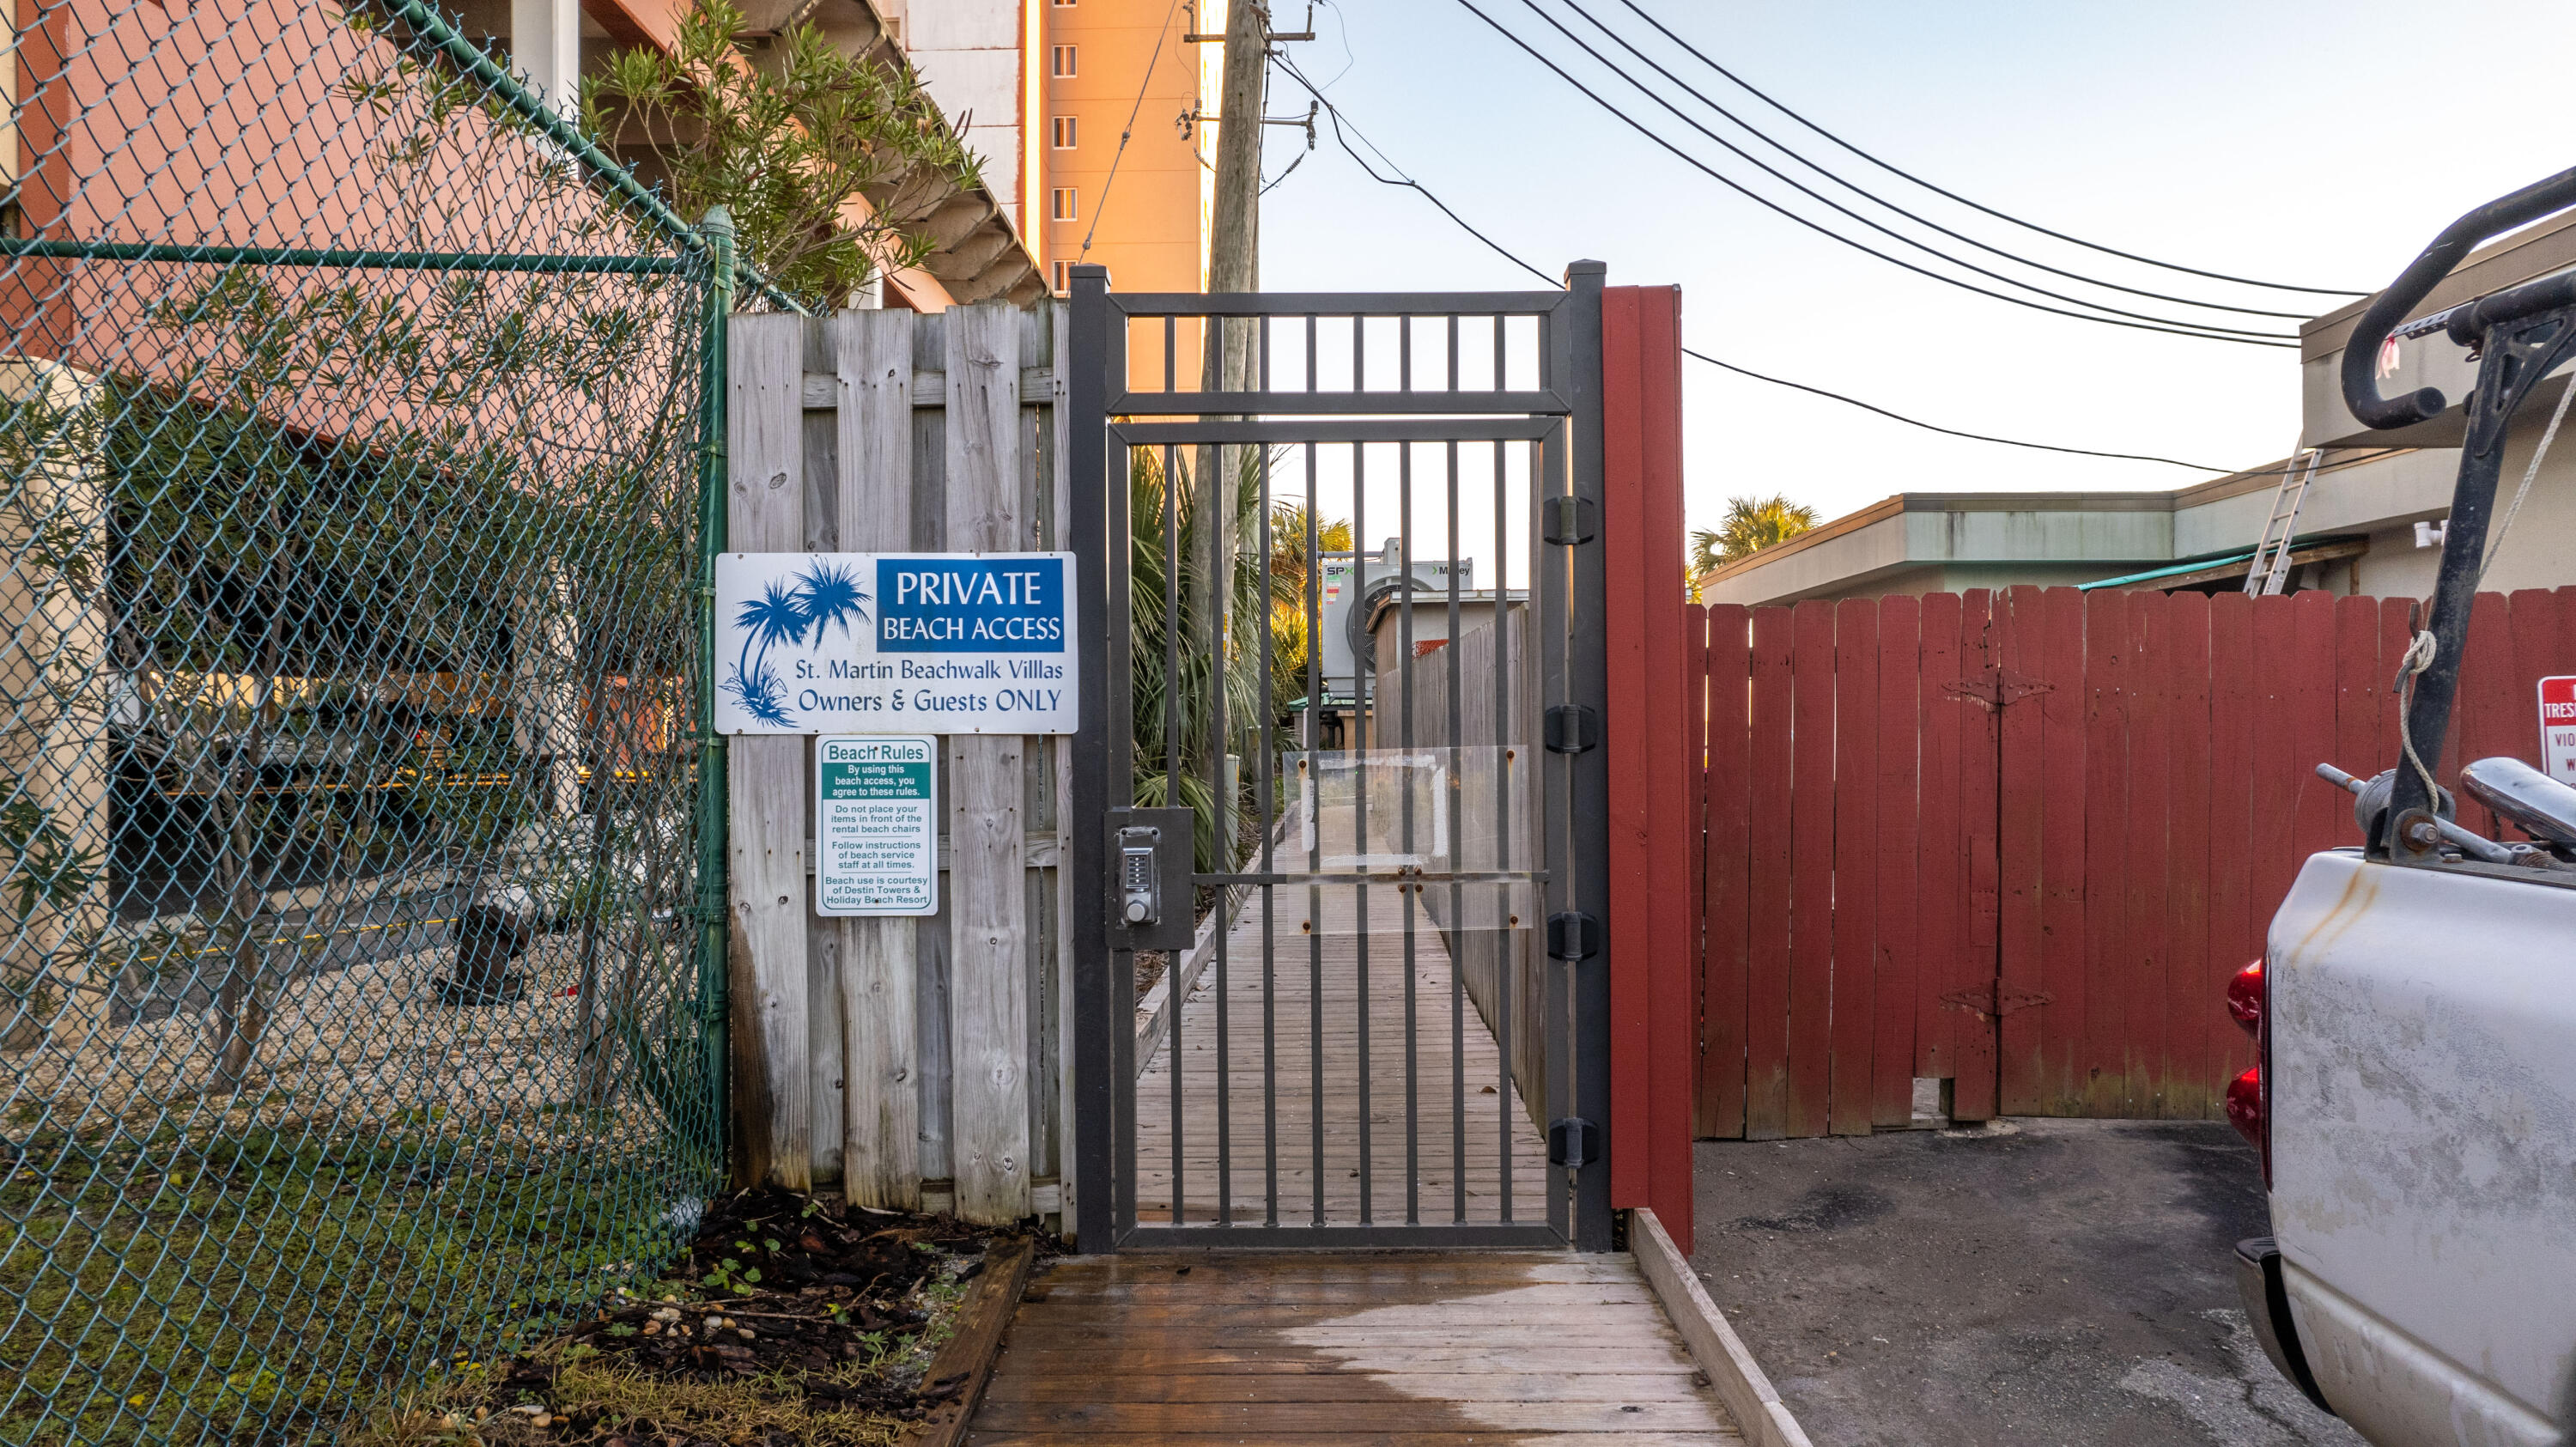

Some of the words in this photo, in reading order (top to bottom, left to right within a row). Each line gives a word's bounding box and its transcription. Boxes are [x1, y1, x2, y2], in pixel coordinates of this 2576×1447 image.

[1327, 567, 1354, 575] SPX
[897, 572, 1042, 605] PRIVATE
[884, 617, 963, 640] BEACH
[971, 617, 1060, 640] ACCESS
[796, 660, 820, 679] St.
[829, 660, 893, 679] Martin
[902, 660, 1001, 679] Beachwalk
[1008, 660, 1063, 679] Villlas
[799, 689, 882, 711] Owners
[891, 689, 905, 711] &
[914, 689, 987, 711] Guests
[996, 689, 1061, 711] ONLY
[2544, 702, 2576, 718] TRES
[2555, 733, 2576, 746] VIO
[829, 745, 876, 760] Beach
[881, 745, 924, 760] Rules
[848, 764, 860, 775] By
[862, 764, 886, 775] using
[888, 764, 905, 774] this
[835, 776, 861, 785] beach
[898, 777, 914, 787] you
[832, 789, 857, 799] agree
[859, 787, 868, 796] to
[870, 787, 894, 796] these
[896, 787, 920, 796] rules.
[835, 805, 848, 813] Do
[869, 805, 894, 815] place
[896, 806, 918, 815] your
[869, 813, 893, 823] front
[895, 813, 905, 823] of
[907, 814, 922, 823] the
[861, 824, 890, 833] beach
[892, 824, 920, 833] chairs
[832, 841, 863, 849] Follow
[866, 841, 921, 849] instructions
[838, 851, 848, 860] of
[850, 851, 878, 860] beach
[838, 860, 860, 869] staff
[872, 860, 884, 869] all
[825, 876, 854, 885] Beach
[877, 876, 884, 885] is
[887, 877, 928, 885] courtesy
[877, 885, 911, 894] Towers
[914, 885, 920, 894] &
[826, 896, 861, 905] Holiday
[865, 896, 893, 904] Beach
[896, 896, 927, 904] Resort
